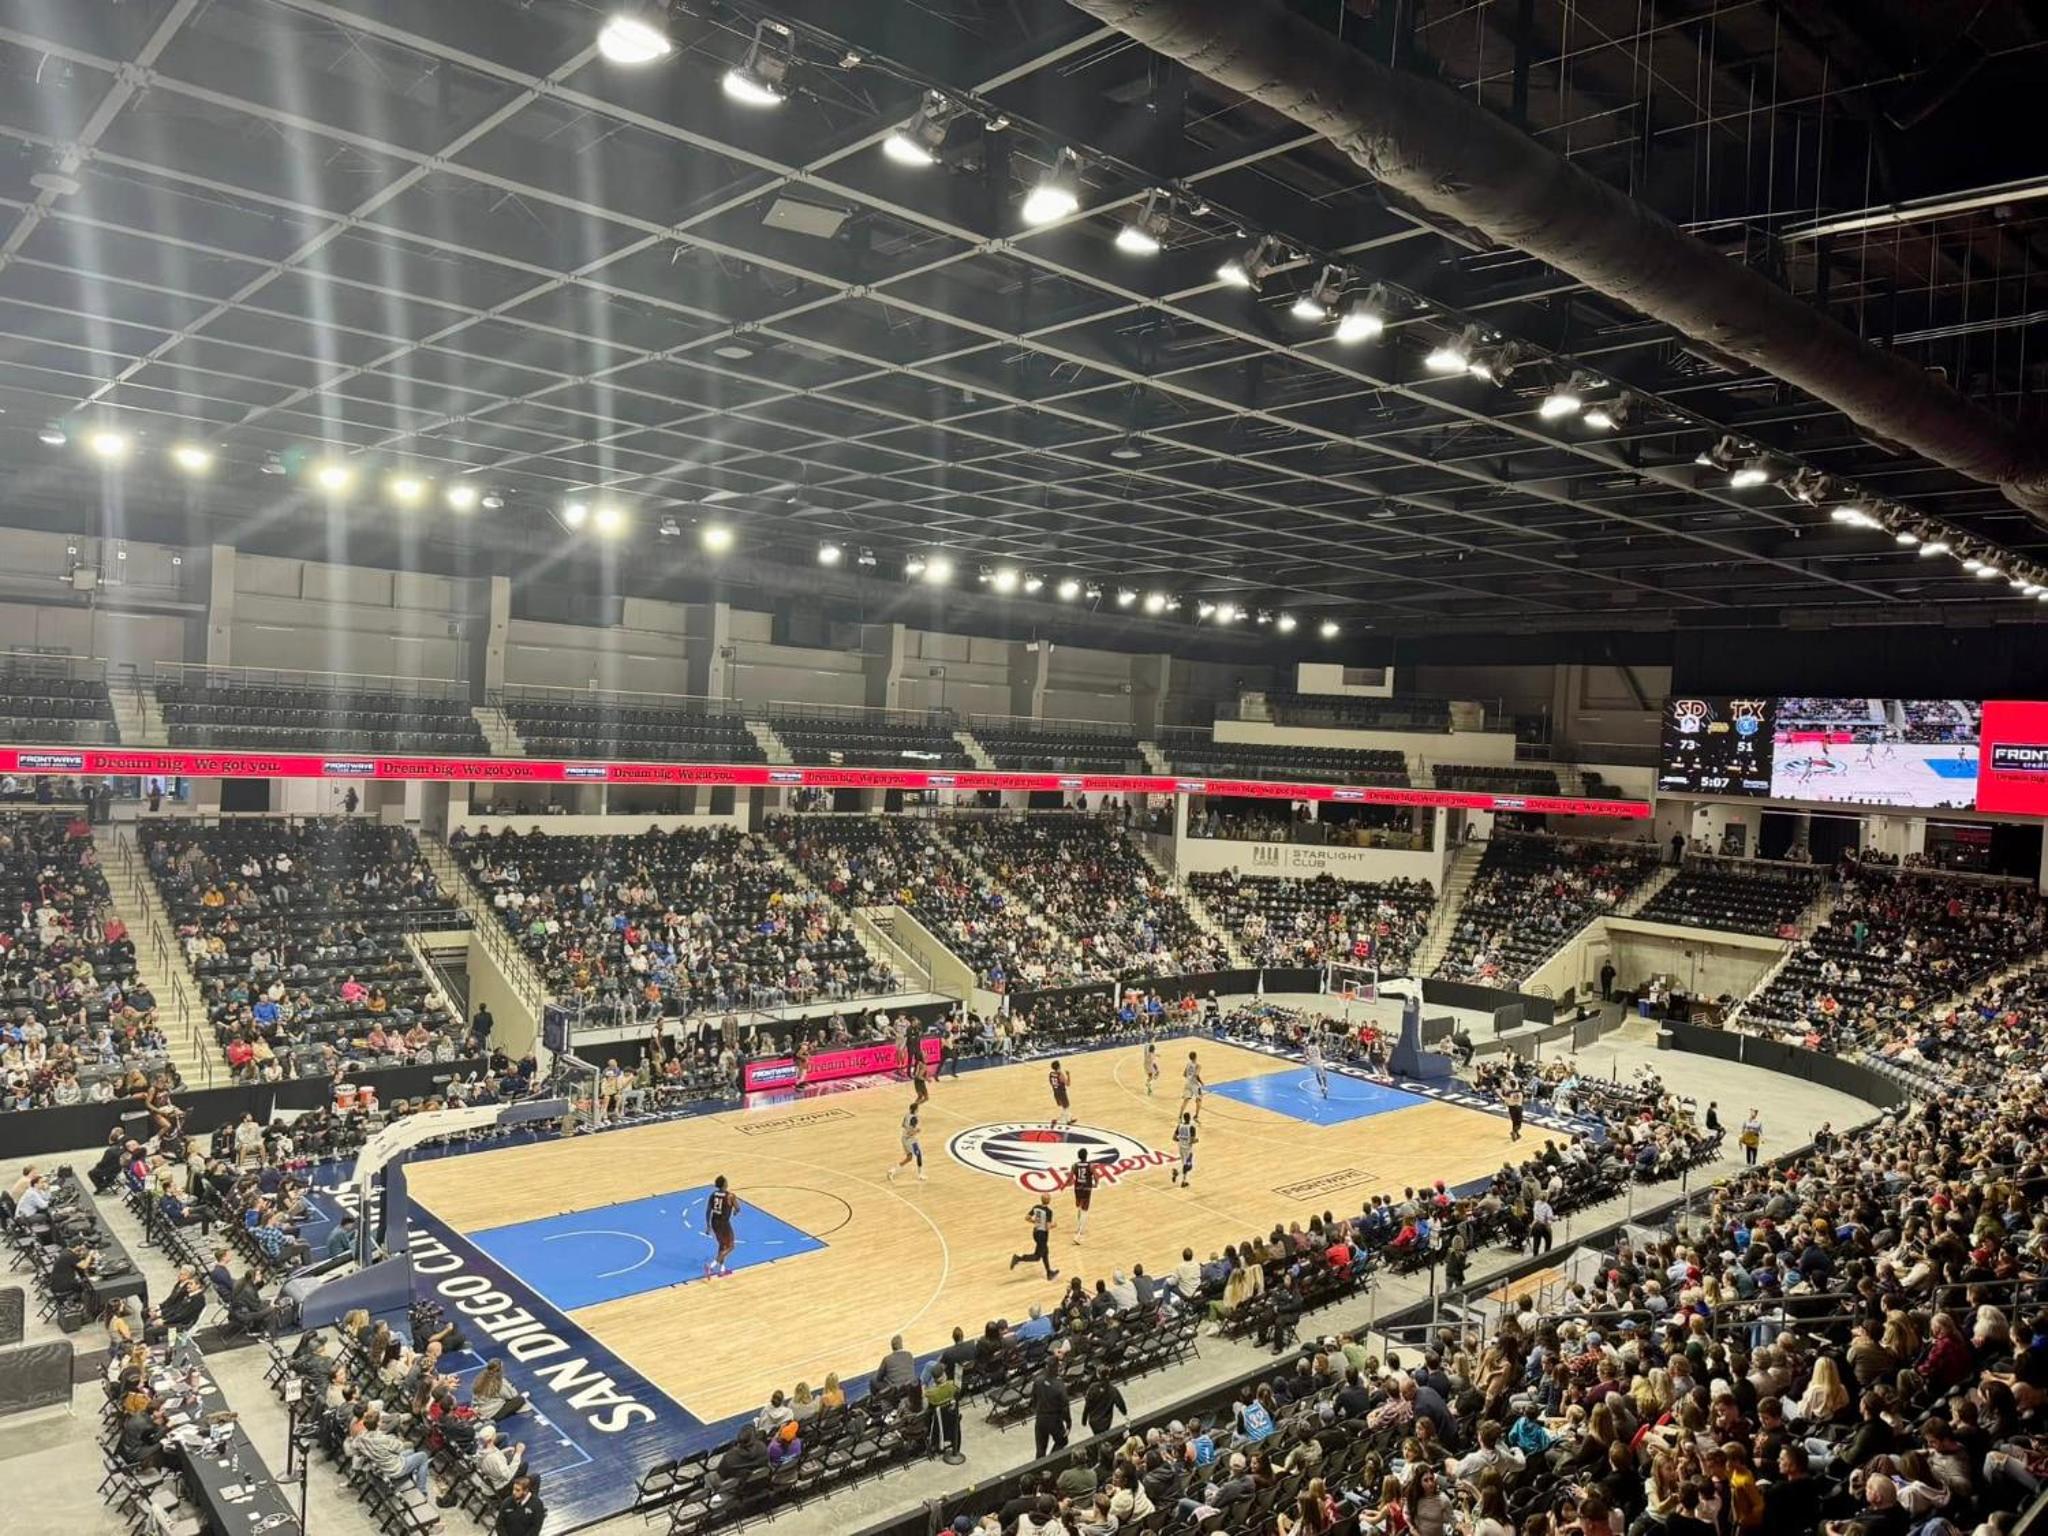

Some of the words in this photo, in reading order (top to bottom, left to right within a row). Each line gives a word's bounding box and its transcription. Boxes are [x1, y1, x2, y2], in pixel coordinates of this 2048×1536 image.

[1674, 700, 1707, 719] SD
[1730, 700, 1766, 721] TX
[1680, 740, 1695, 750] 73
[1737, 742, 1753, 752] 51
[94, 756, 151, 769] Dream
[195, 758, 217, 770] We
[383, 762, 429, 774] Dream
[463, 764, 481, 775] We
[1701, 777, 1729, 788] 5:07
[1293, 850, 1365, 861] STARLIGHT
[1292, 860, 1326, 868] CLUB
[1019, 1149, 1180, 1194] Clipers
[436, 1274, 571, 1364] DIEGO
[532, 1357, 656, 1433] SAN
